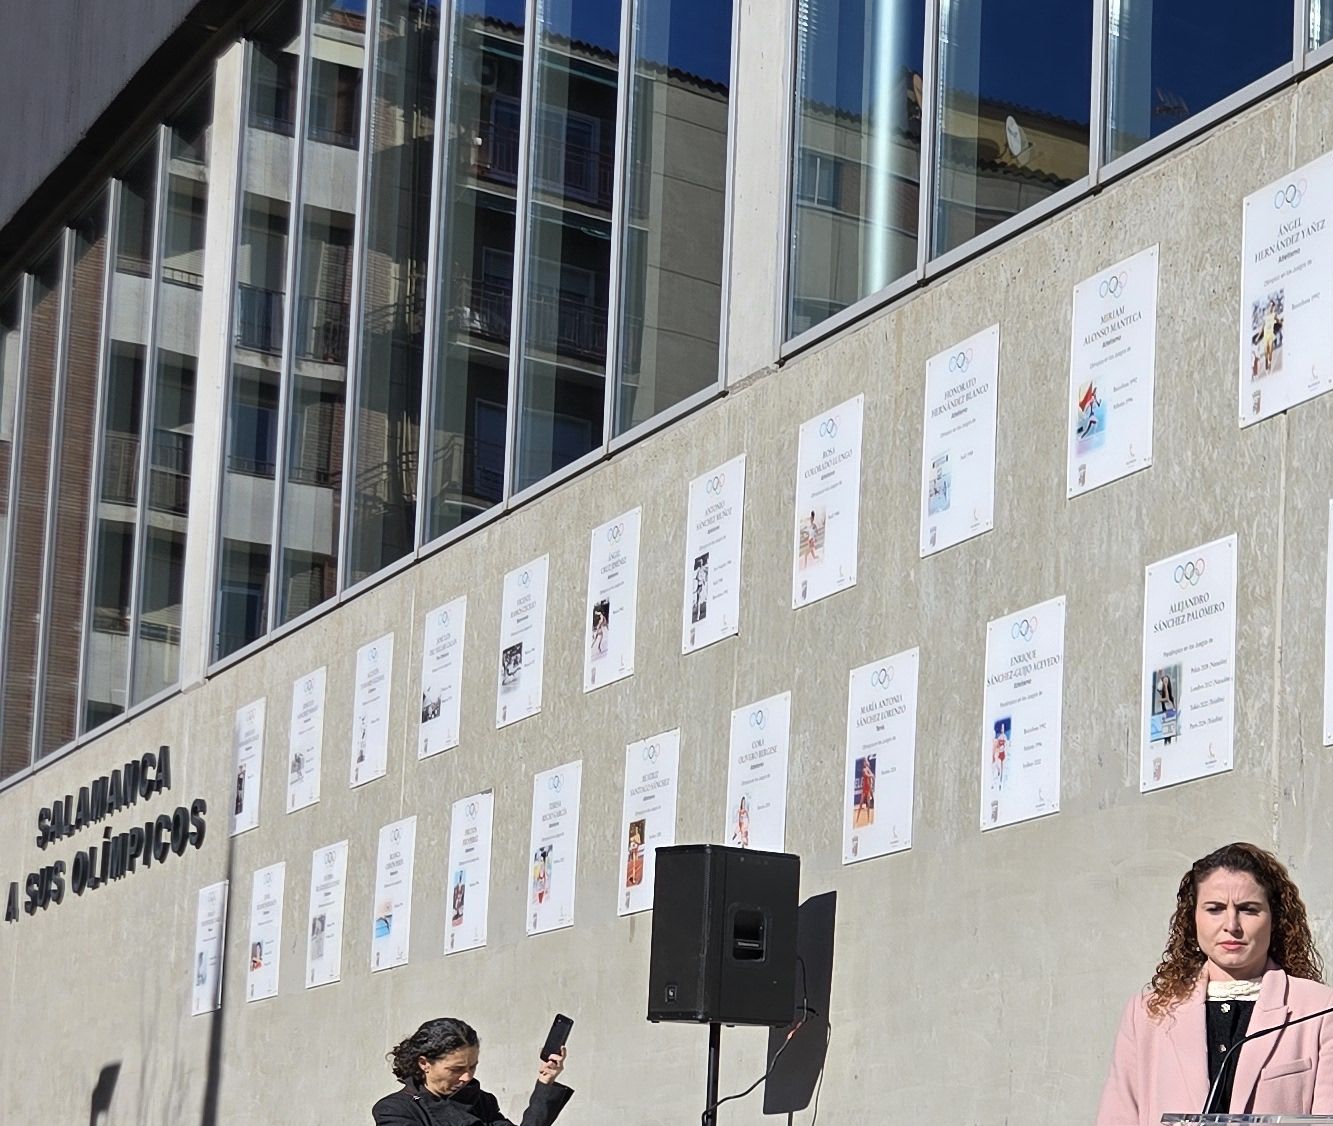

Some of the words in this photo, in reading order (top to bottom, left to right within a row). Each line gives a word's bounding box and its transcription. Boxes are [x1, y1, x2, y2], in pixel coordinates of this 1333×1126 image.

[1278, 217, 1301, 237] ÁNGEL
[1254, 231, 1300, 263] HERNÁNDEZ
[1100, 305, 1125, 325] MIRIAM
[1083, 326, 1110, 346] ALONSO
[944, 377, 977, 400] HONORATO
[931, 394, 966, 418] HERNÁNDEZ
[965, 383, 989, 401] BLANCO
[1169, 592, 1210, 615] ALEJANDRO
[1153, 615, 1186, 633] SÁNCHEZ
[1186, 601, 1225, 622] PALOMERO
[1010, 650, 1037, 667] ENRIQUE
[1033, 654, 1060, 670] ACEVEDO
[37, 746, 171, 851] SALAMANCA
[5, 882, 19, 924] A
[25, 860, 66, 916] SUS
[72, 799, 207, 896] OLÍMPICOS
